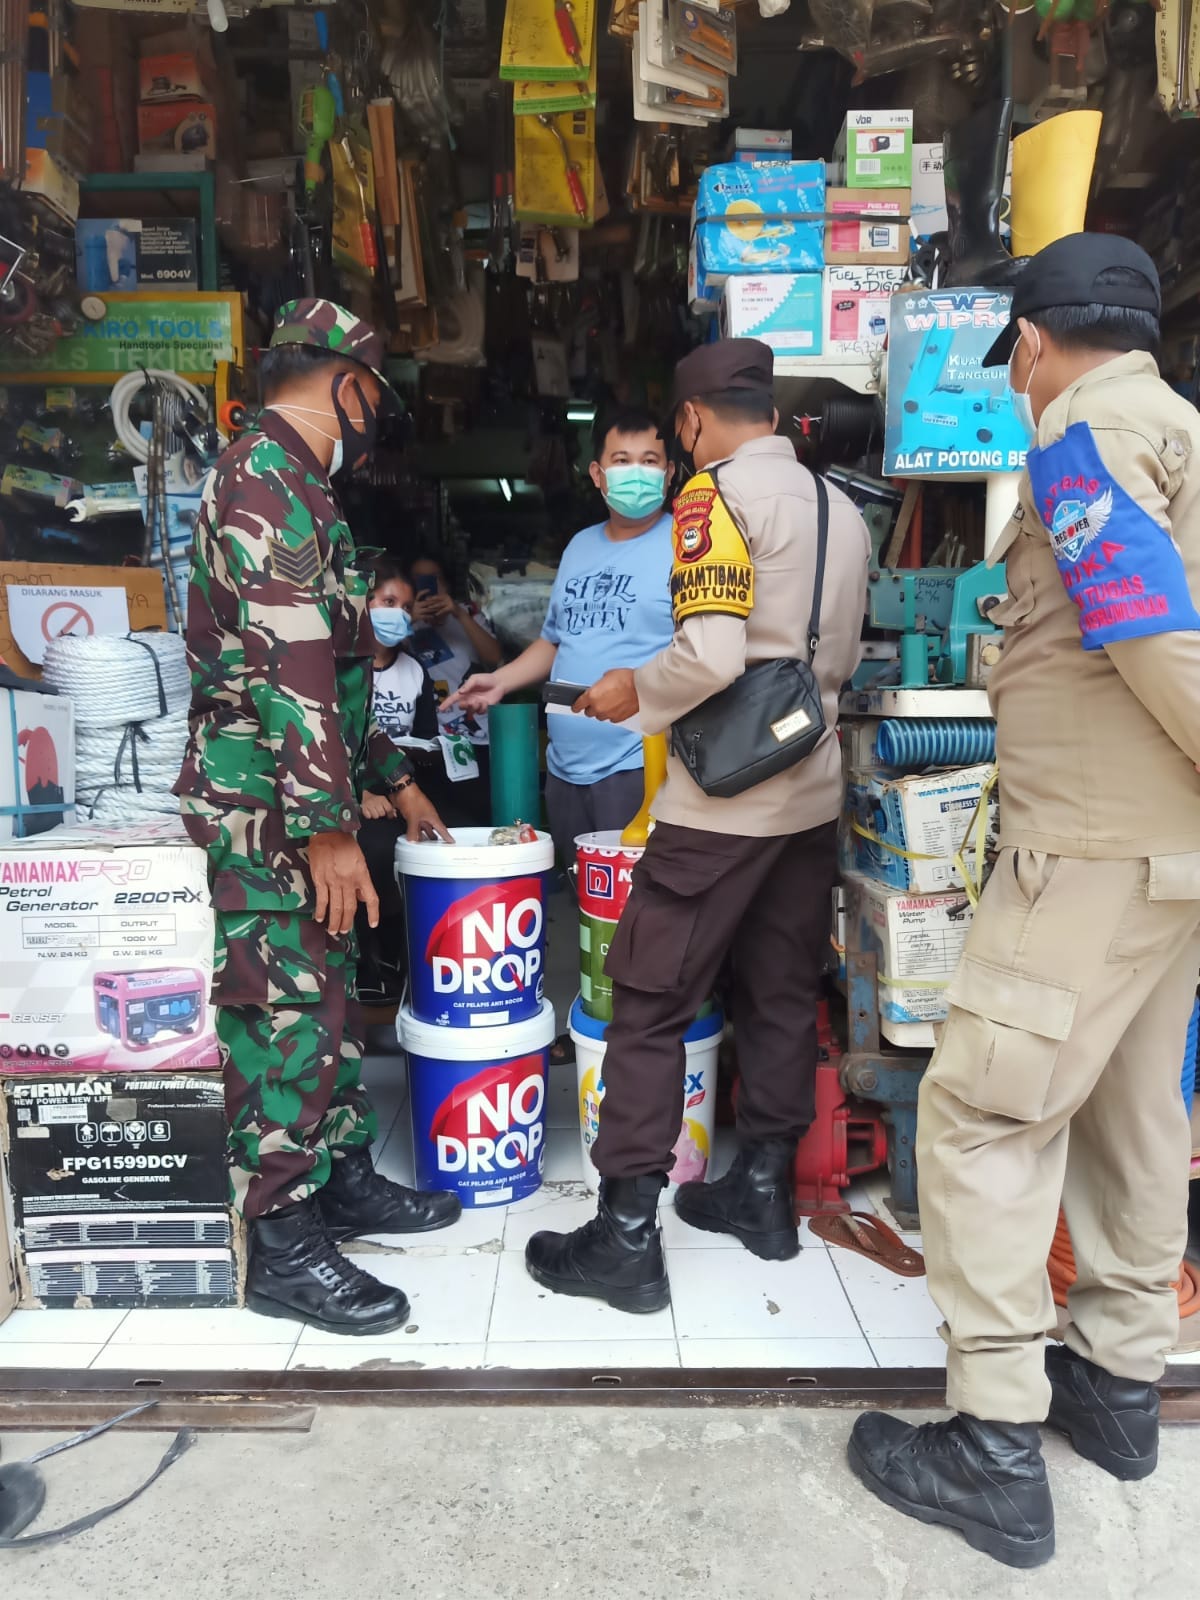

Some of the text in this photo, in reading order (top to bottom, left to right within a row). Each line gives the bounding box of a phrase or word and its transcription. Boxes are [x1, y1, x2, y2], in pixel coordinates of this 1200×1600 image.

[157, 269, 191, 279] 6904V
[829, 266, 862, 283] FUEL
[150, 319, 223, 339] TOOLS
[119, 341, 223, 351] Handtools Specialist
[947, 370, 1007, 381] TANGGUH
[895, 453, 933, 469] ALAT
[938, 450, 1002, 467] POTONG
[21, 588, 103, 598] DILARANG MASUK
[680, 586, 748, 604] BUTUNG
[564, 607, 631, 636] LISTEN
[0, 886, 52, 898] Petrol
[6, 901, 99, 912] Generator
[896, 898, 935, 911] YAMAMAX
[120, 920, 158, 928] OUTPUT
[462, 897, 543, 954] NO
[432, 948, 541, 995] DROP
[13, 1082, 113, 1099] FIRMAN
[124, 1081, 162, 1091] PORTABLE
[161, 1081, 186, 1090] POWER
[466, 1073, 545, 1134] NO
[155, 1123, 165, 1135] 6
[436, 1122, 544, 1174] DROP
[62, 1154, 188, 1171] FPG1599DCV
[82, 1175, 170, 1184] GASOLINE GENERATOR
